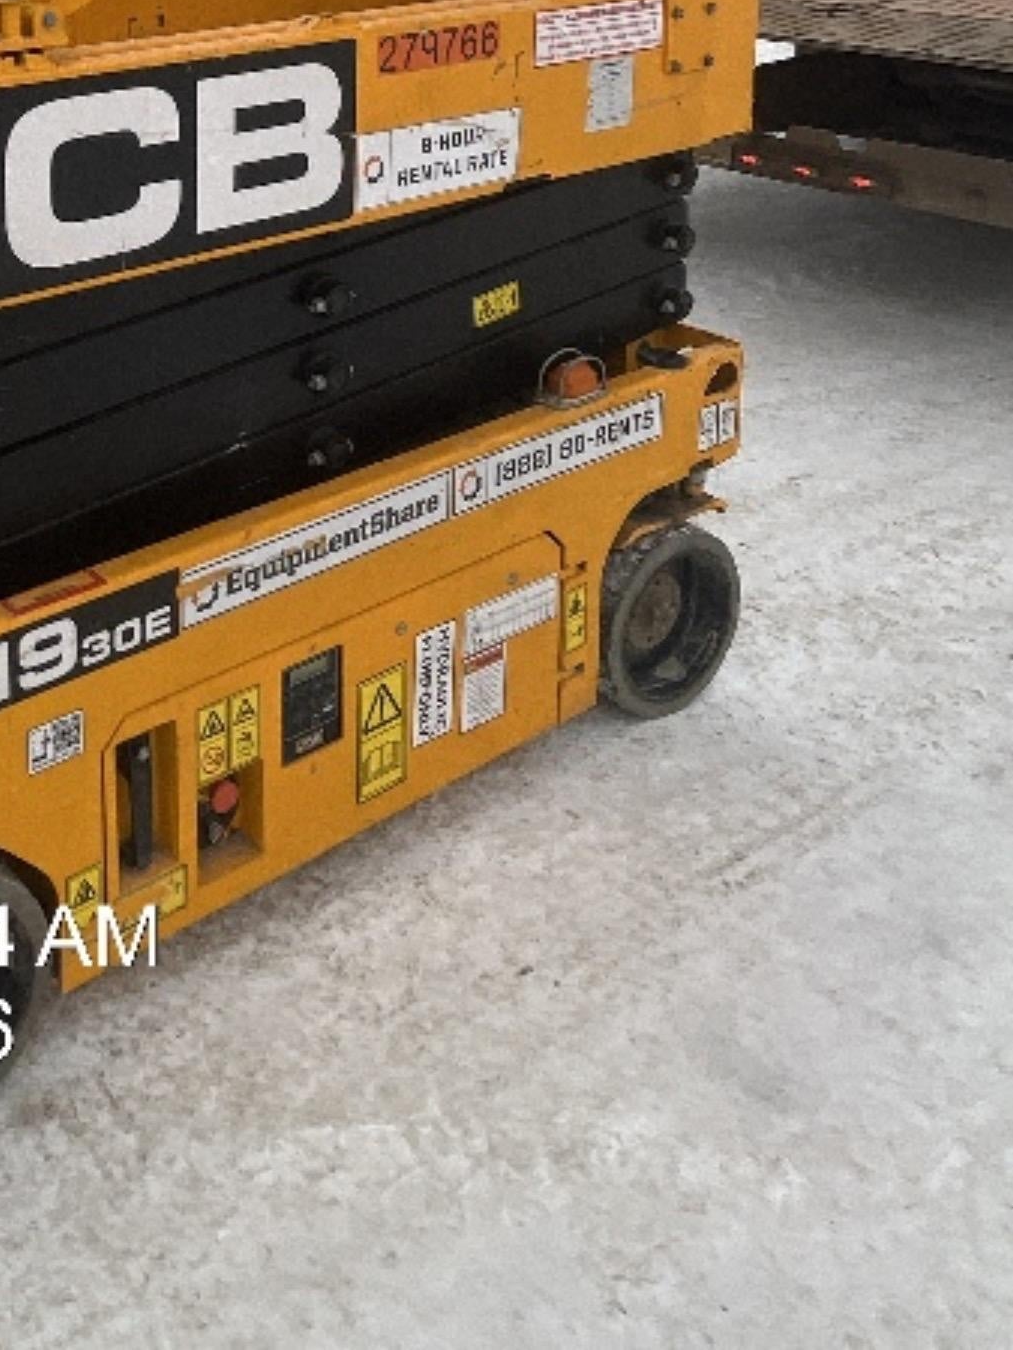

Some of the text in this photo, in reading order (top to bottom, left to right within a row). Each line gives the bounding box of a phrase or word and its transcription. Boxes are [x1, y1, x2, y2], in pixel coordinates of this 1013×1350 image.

[379, 20, 499, 74] 279766
[468, 150, 508, 172] RATE
[226, 494, 439, 595] EquipmentShare
